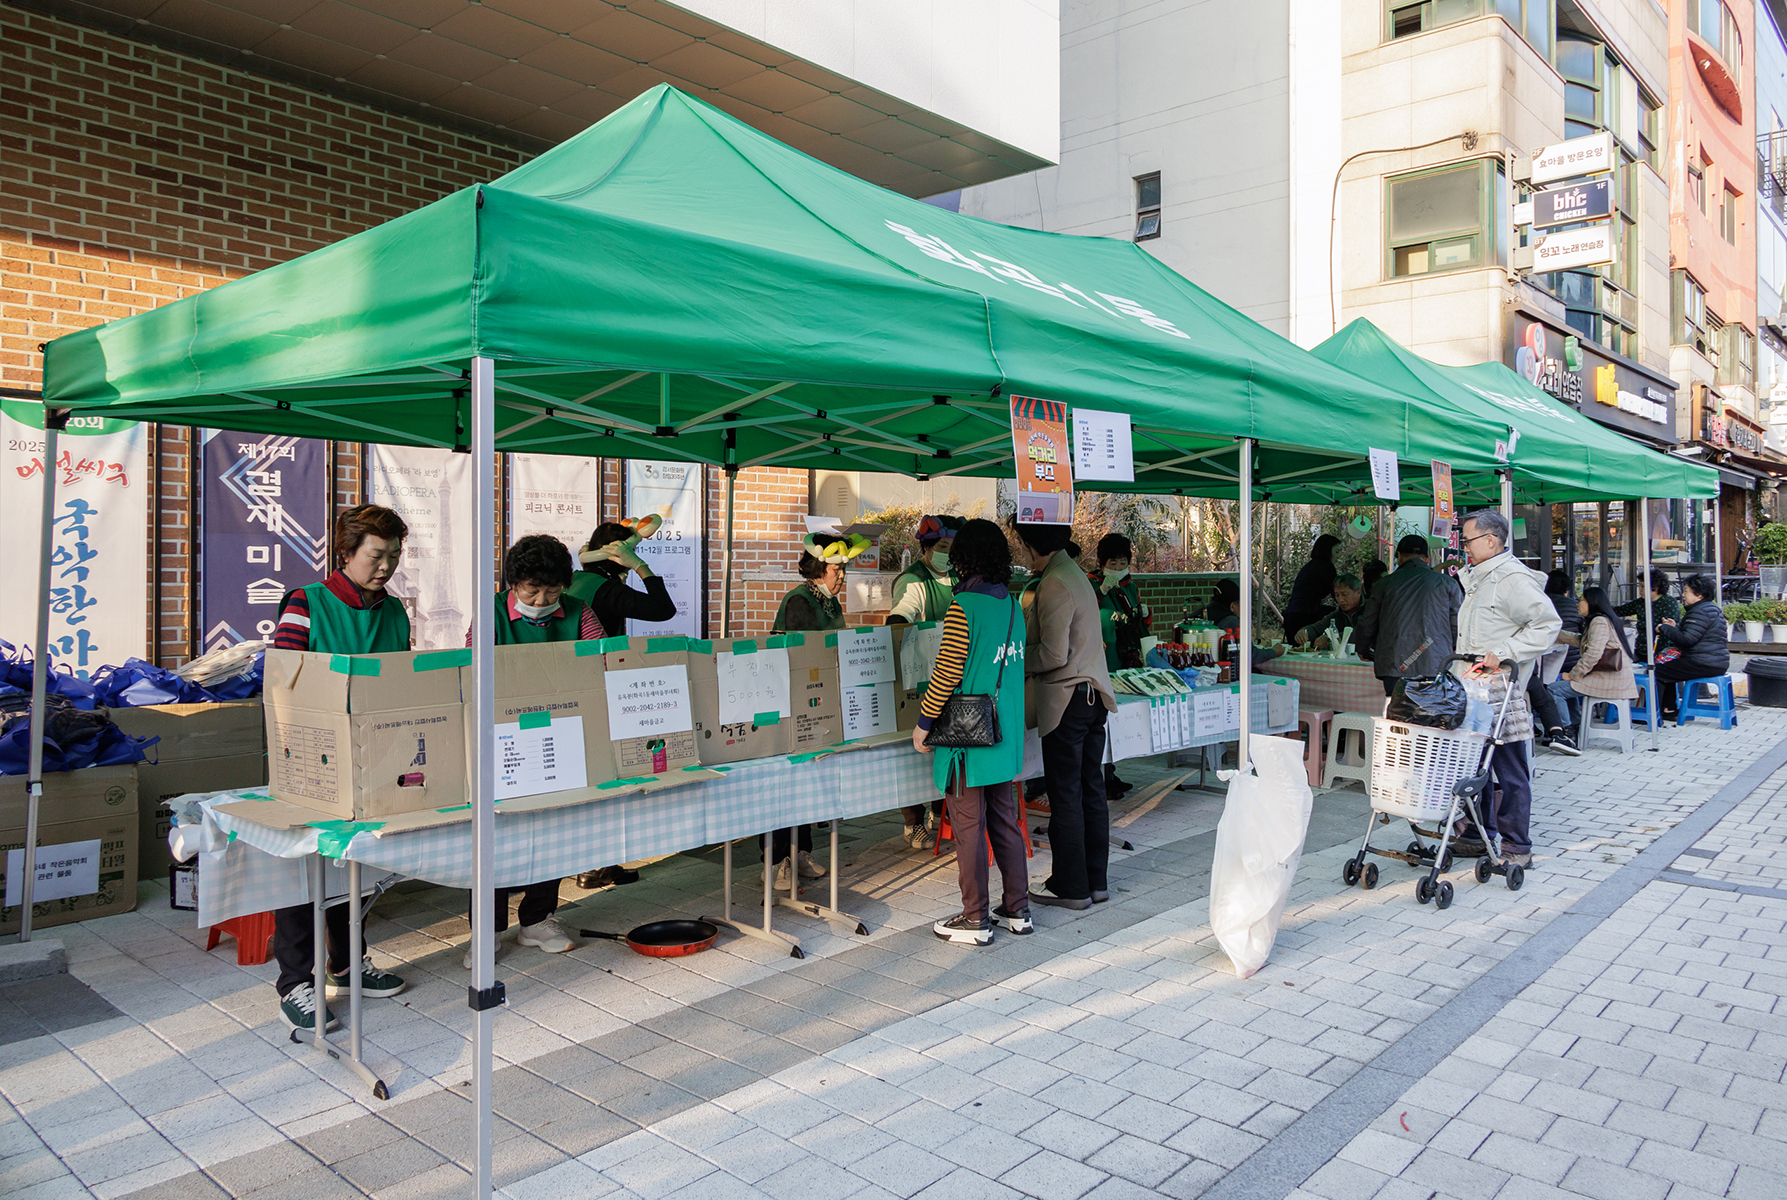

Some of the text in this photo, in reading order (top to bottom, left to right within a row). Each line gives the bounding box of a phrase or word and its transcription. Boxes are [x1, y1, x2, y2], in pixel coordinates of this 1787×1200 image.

[1567, 147, 1603, 163] 방문요양
[1596, 181, 1607, 190] 1F
[1553, 190, 1588, 211] bhc
[1553, 207, 1588, 221] CHICKEN
[1540, 239, 1605, 258] 잉꼬 노래 연습장
[238, 443, 295, 461] 제17회
[1027, 445, 1057, 464] 먹거리
[1035, 463, 1055, 481] 부스
[374, 484, 437, 498] RADIOPERA
[525, 502, 584, 515] 피크닉 콘서트
[664, 545, 691, 555] 프로그램
[48, 498, 99, 683] 국악한마
[621, 701, 678, 713] 9002-2042-2189-3
